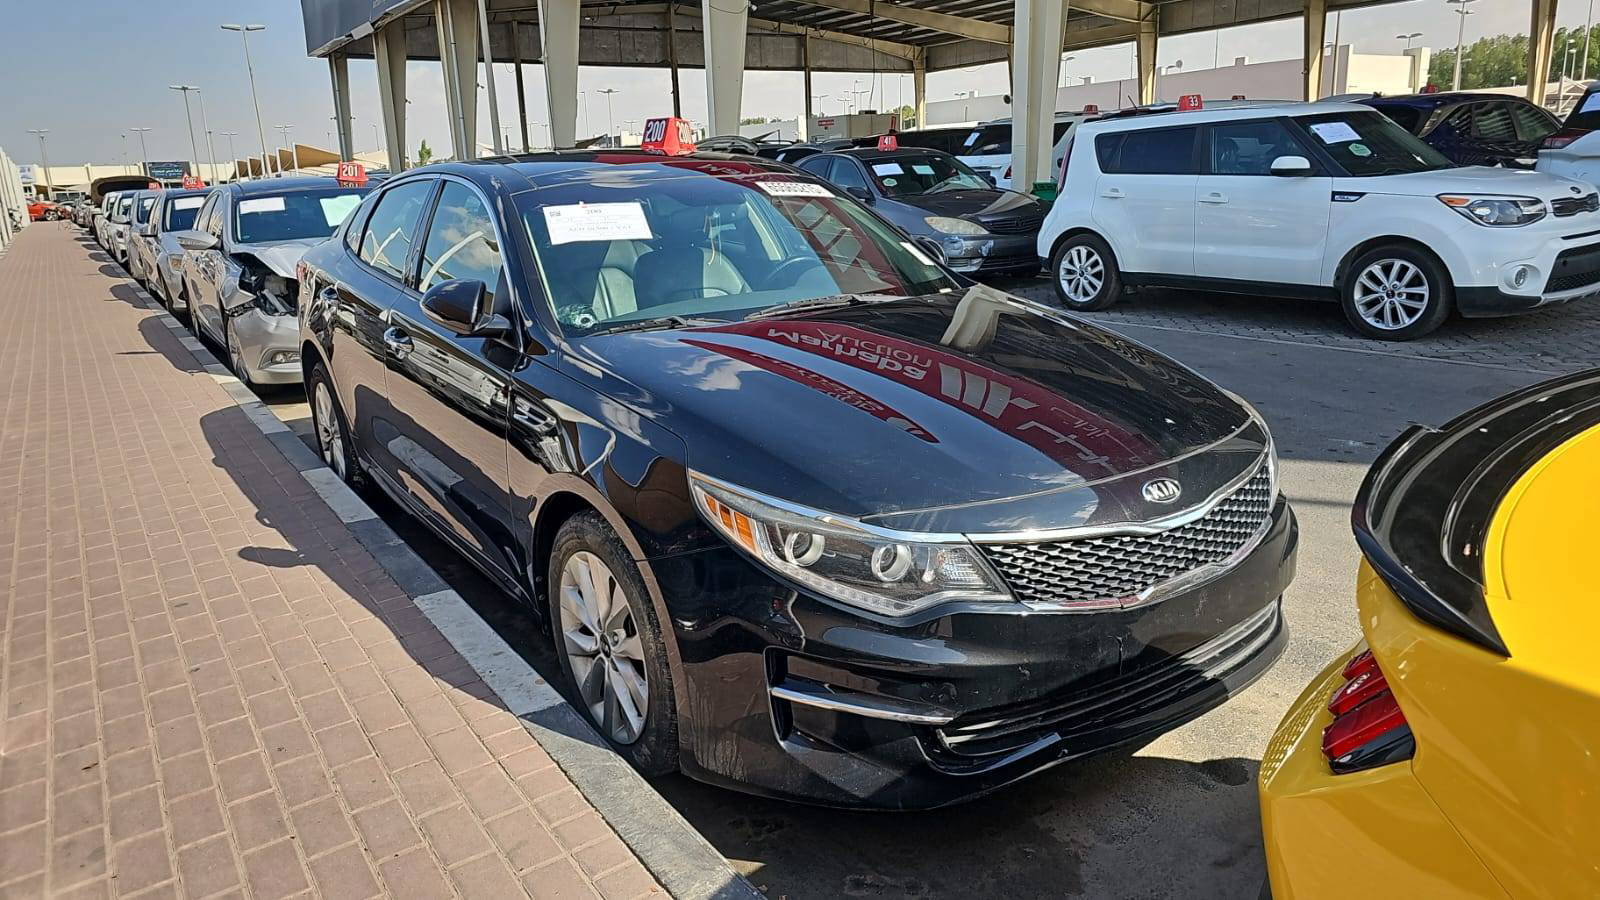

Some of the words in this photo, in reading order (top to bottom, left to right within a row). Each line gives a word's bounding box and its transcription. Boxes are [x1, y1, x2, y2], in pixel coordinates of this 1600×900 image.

[1190, 96, 1199, 106] 33
[645, 120, 666, 142] 200
[342, 165, 358, 177] 201
[1147, 480, 1179, 499] KIA
